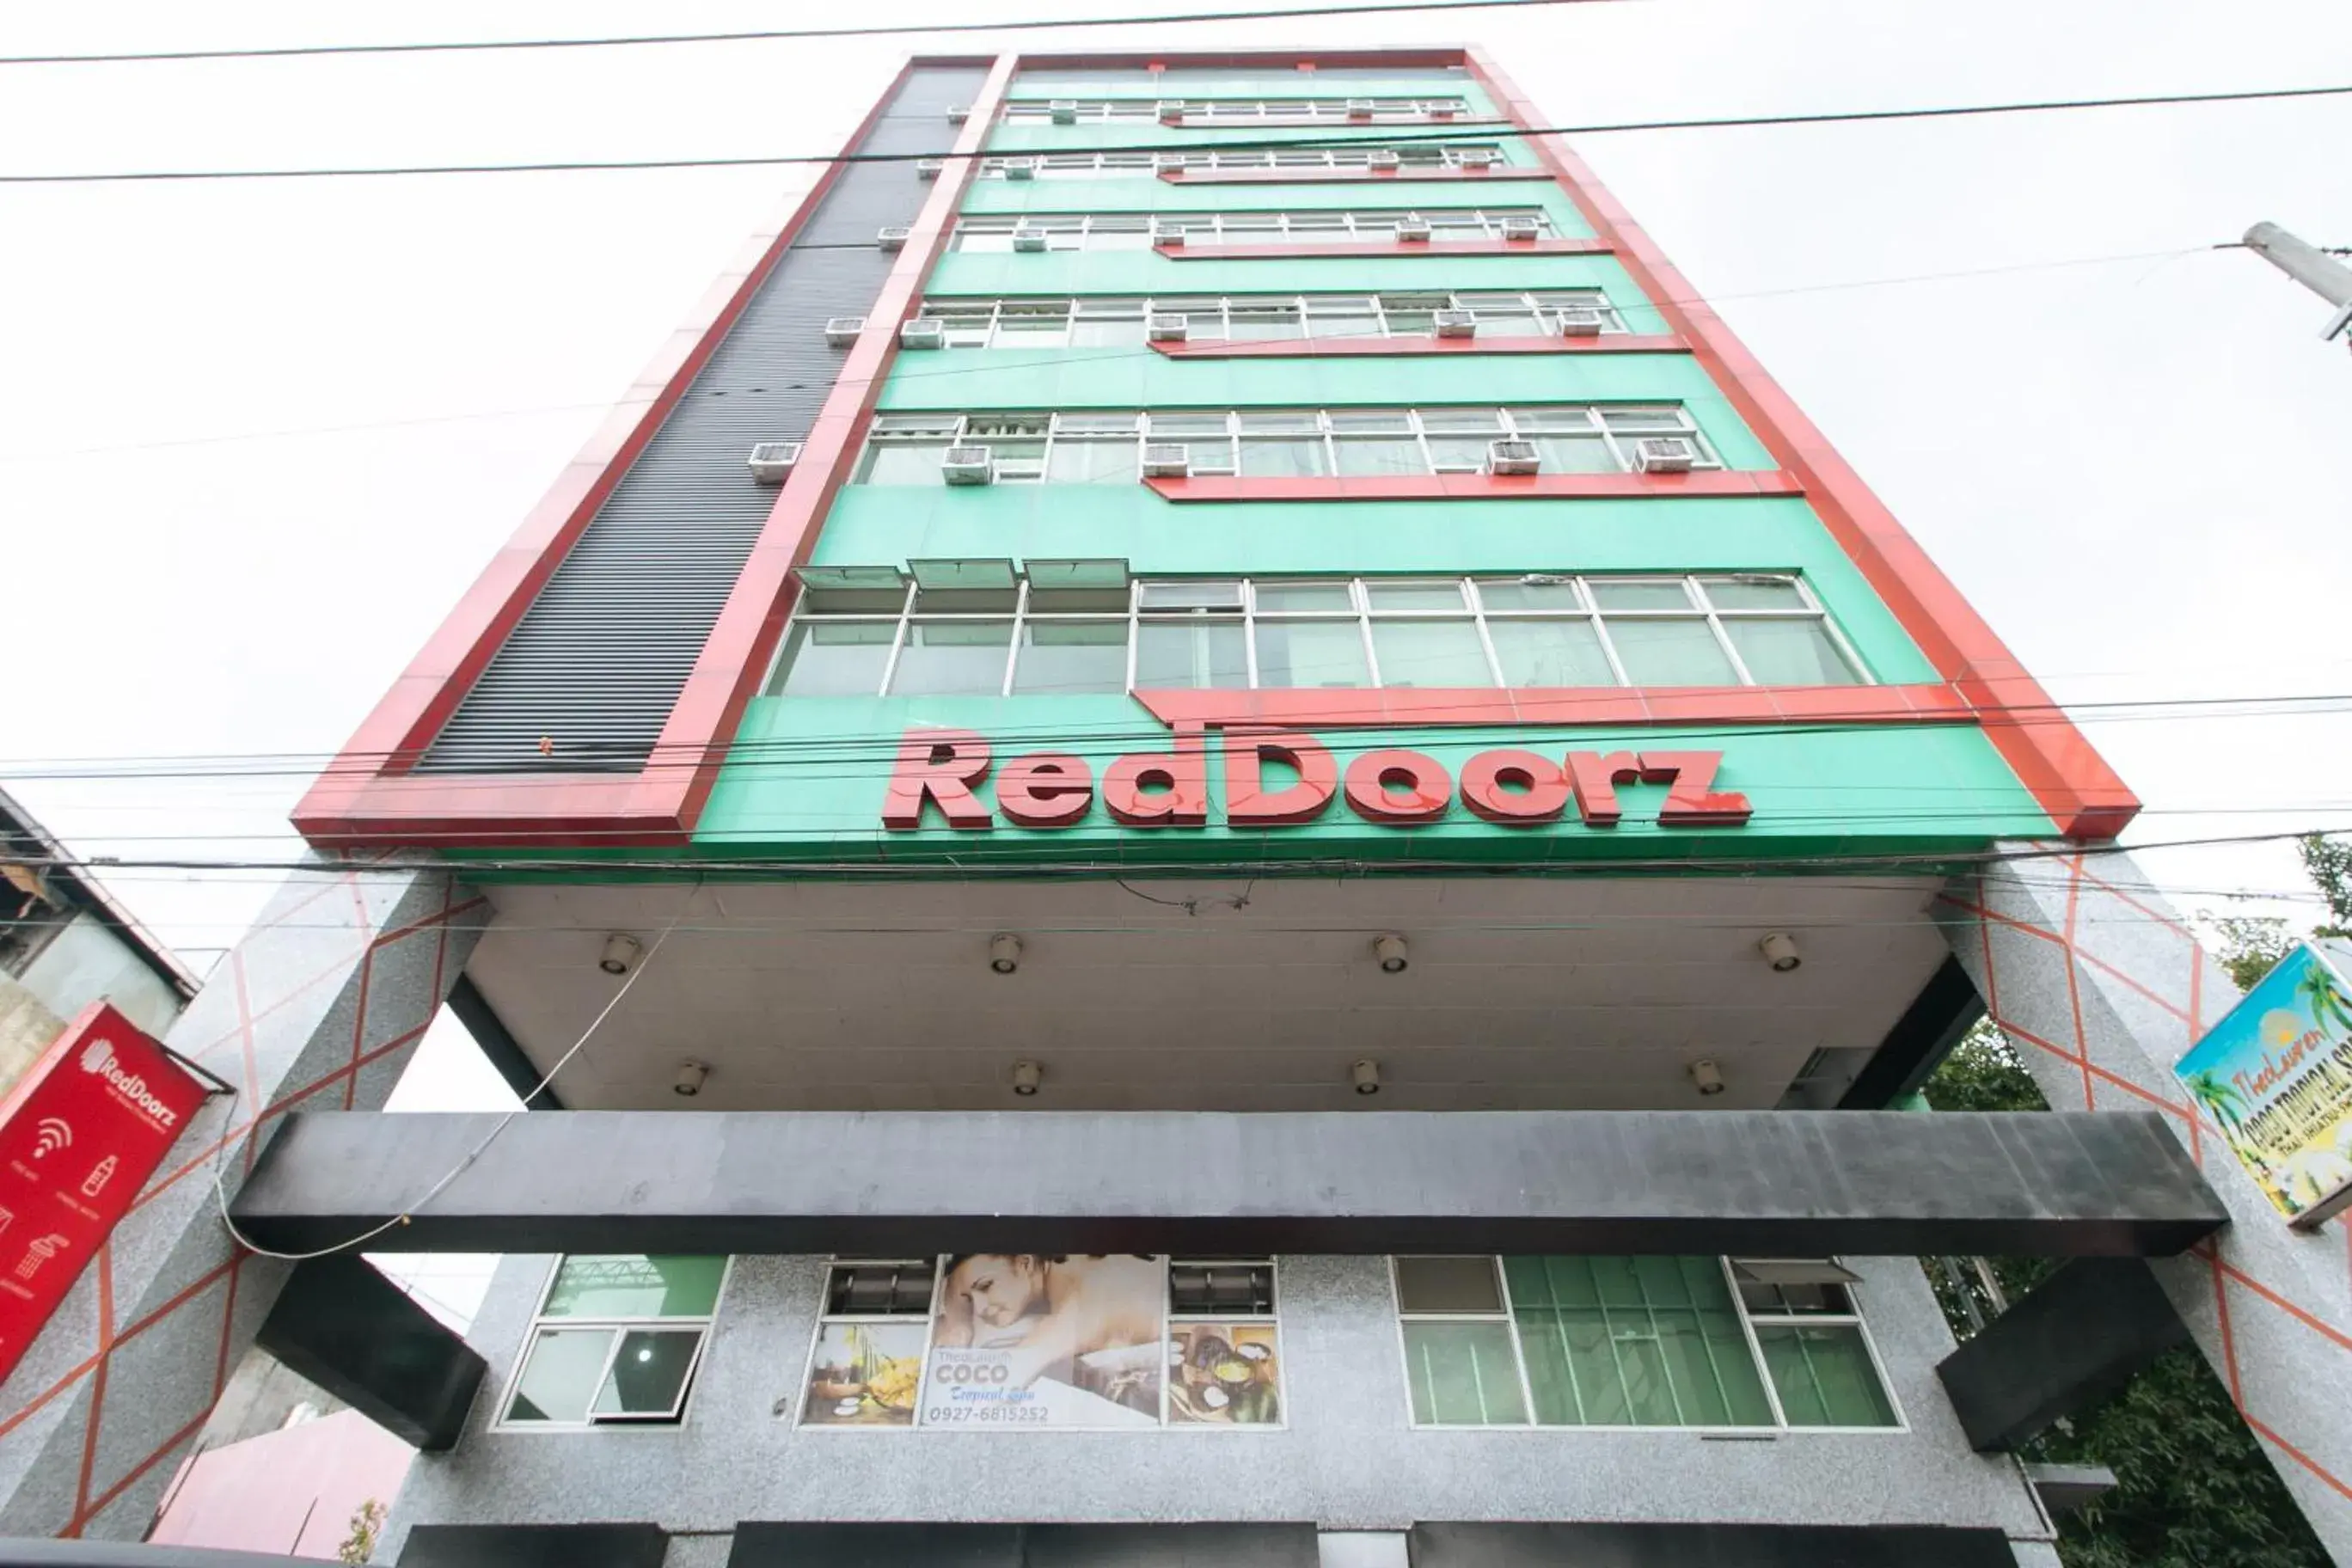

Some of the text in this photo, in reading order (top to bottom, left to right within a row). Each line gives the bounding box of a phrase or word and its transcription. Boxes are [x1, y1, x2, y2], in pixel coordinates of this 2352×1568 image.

[882, 723, 1754, 832] RedDoorz
[100, 1056, 178, 1127] RedDoorz
[935, 1363, 1009, 1384] COCO
